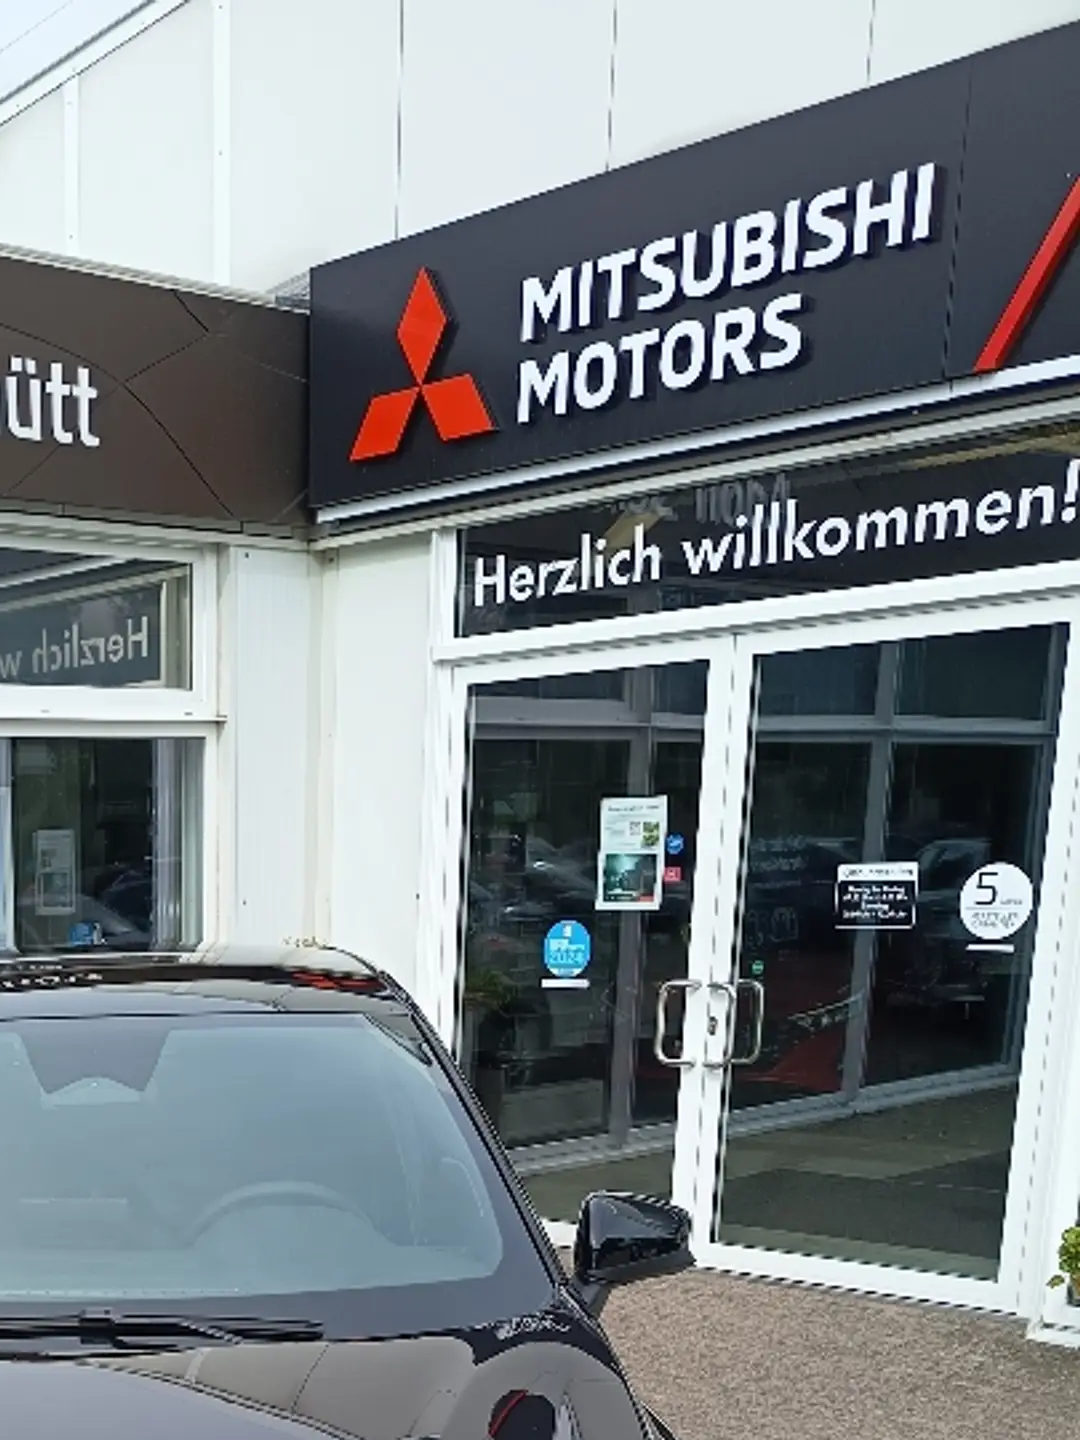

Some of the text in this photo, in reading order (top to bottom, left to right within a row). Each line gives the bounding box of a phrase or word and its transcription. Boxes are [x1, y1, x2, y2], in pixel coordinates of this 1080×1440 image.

[520, 162, 937, 343] MITSUBISHI
[516, 294, 805, 424] MOTORS
[473, 457, 1080, 608] Herzlich willkommen!
[973, 872, 999, 905] 5
